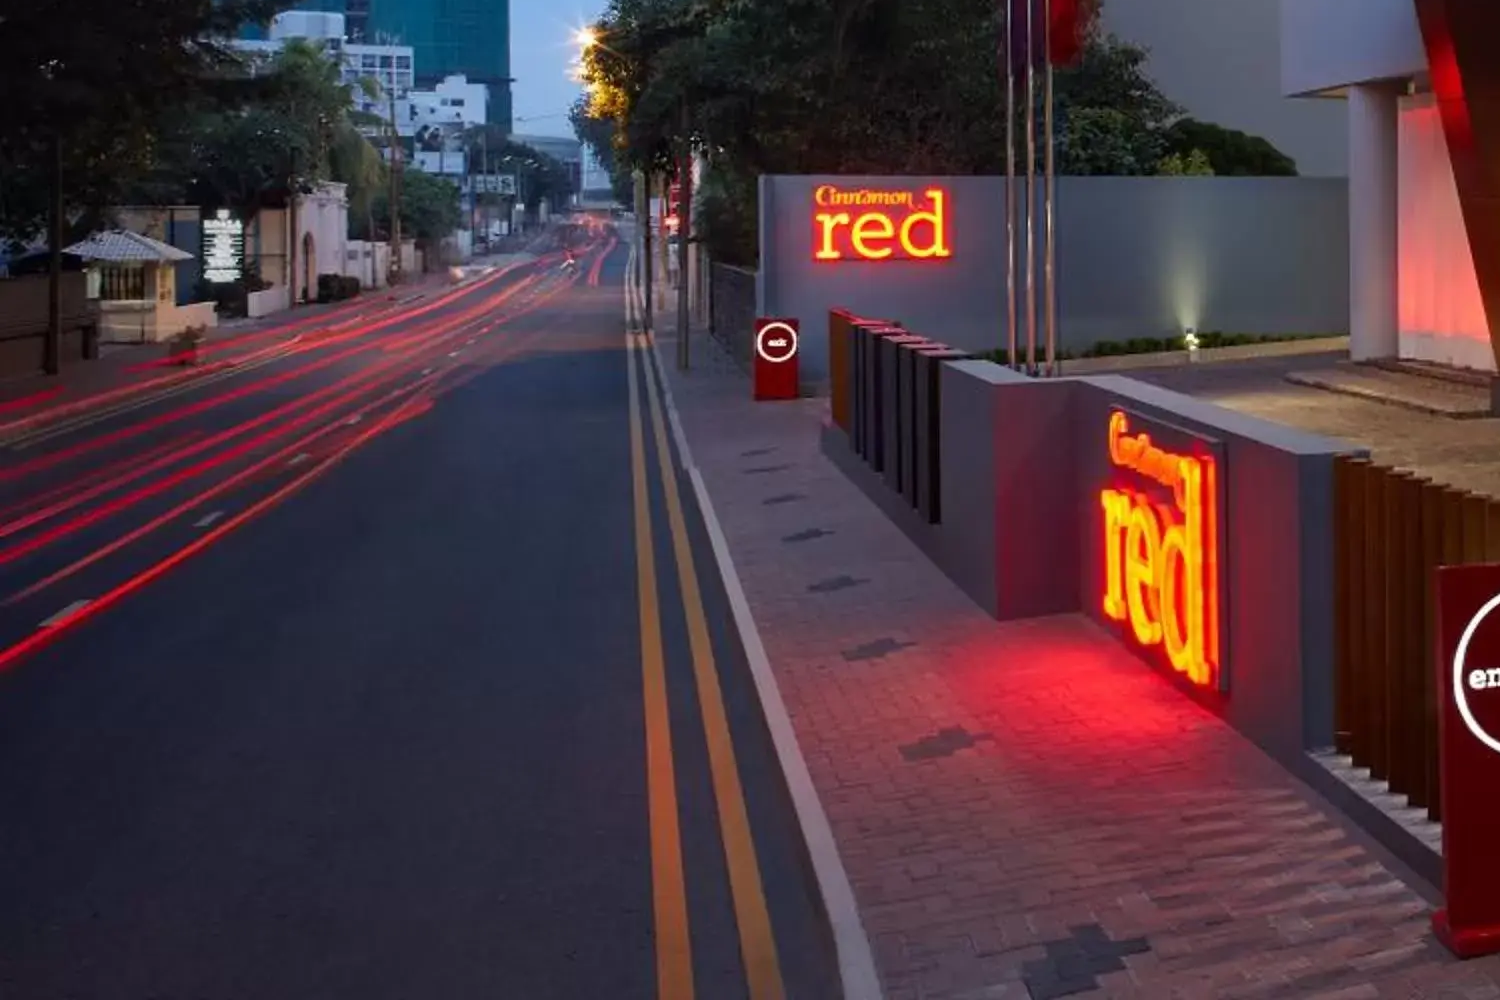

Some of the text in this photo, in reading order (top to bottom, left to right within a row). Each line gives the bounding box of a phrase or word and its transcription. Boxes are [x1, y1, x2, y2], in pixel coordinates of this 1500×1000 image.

[815, 184, 914, 211] Cinnamon
[815, 189, 951, 259] red
[1101, 456, 1213, 685] red
